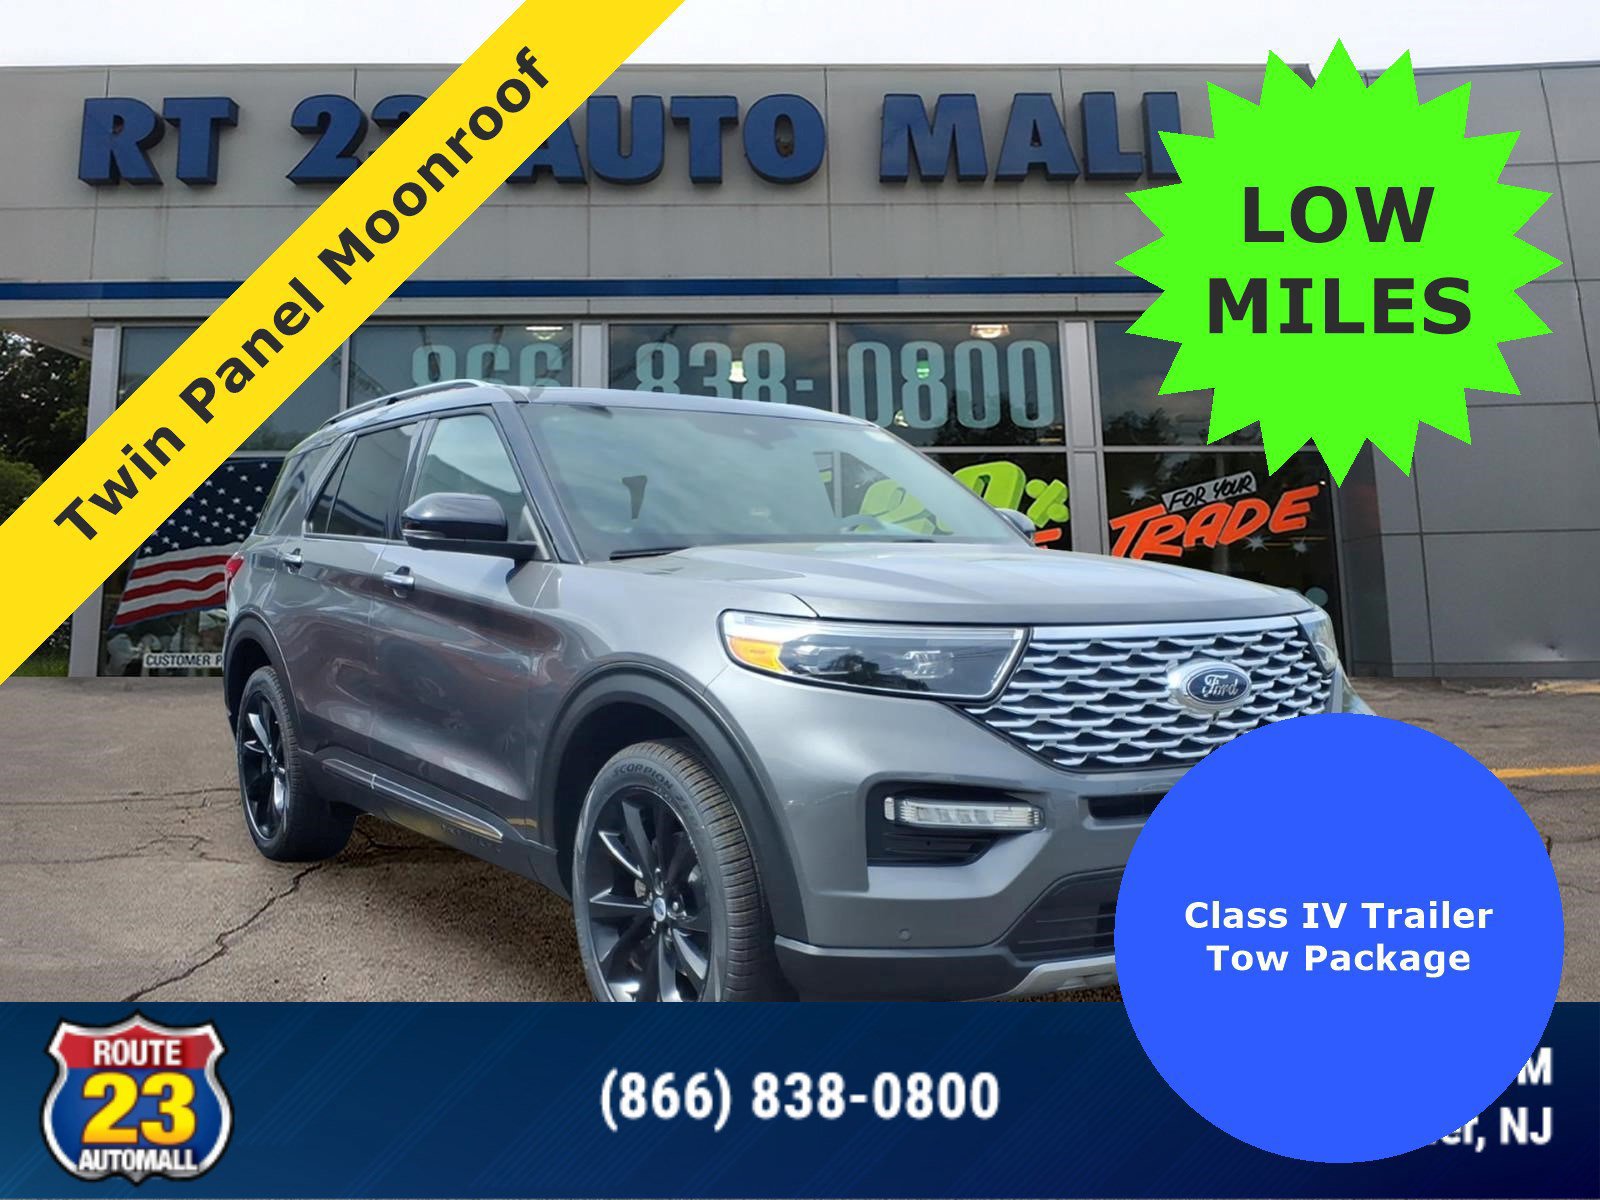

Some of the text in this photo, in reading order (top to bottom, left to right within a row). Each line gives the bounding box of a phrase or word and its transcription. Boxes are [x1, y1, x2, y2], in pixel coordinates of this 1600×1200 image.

[78, 97, 239, 186] RT
[507, 93, 826, 187] AUTO
[1169, 474, 1253, 511] FOR YOUR
[1109, 485, 1320, 560] TRADE
[145, 654, 211, 667] CUSTOMER
[1201, 674, 1239, 698] Ford
